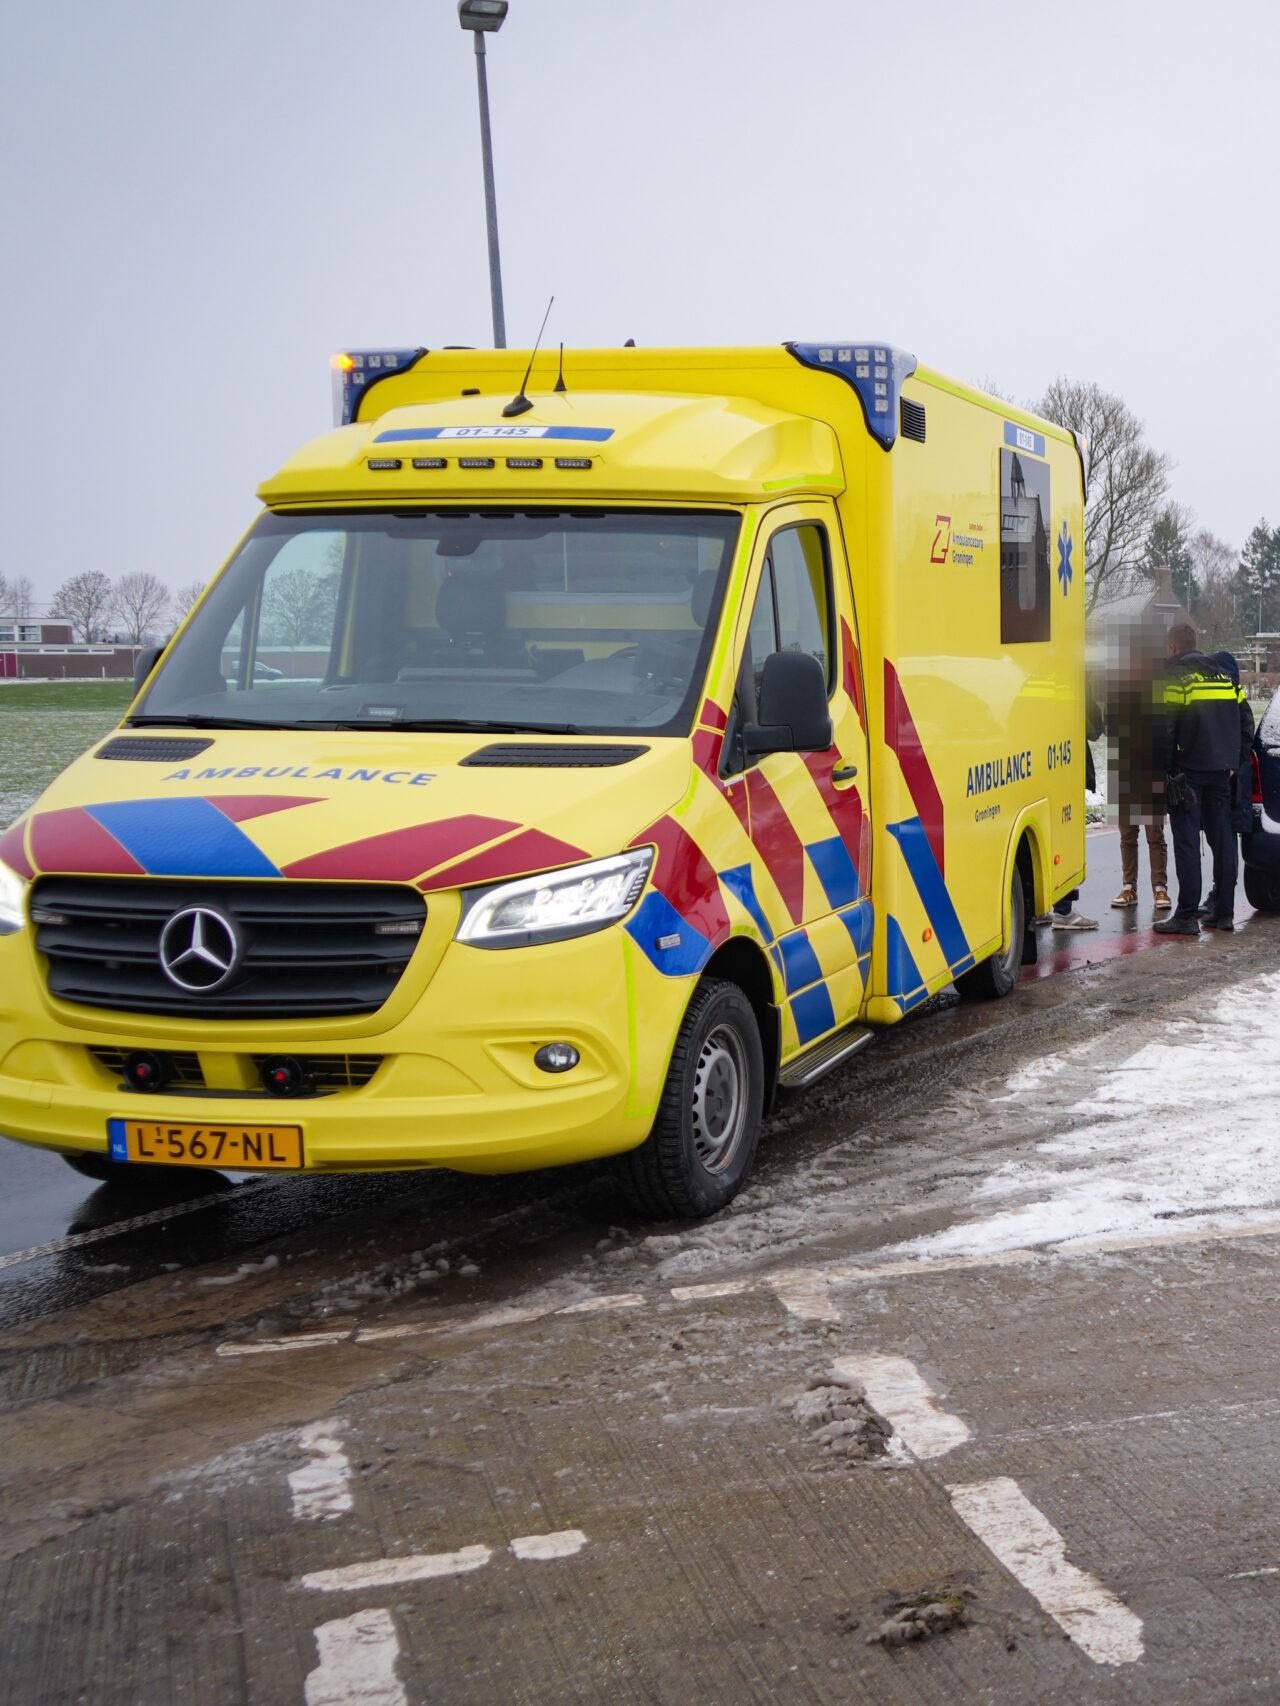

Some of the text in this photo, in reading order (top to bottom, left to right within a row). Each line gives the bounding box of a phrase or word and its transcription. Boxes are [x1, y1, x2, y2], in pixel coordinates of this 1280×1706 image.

[456, 428, 530, 436] 01-145
[160, 766, 437, 786] AMBULANCE
[966, 740, 1071, 798] AMBULANCE 01-145
[975, 804, 1000, 822] Groningen
[113, 1127, 287, 1162] NL L-567-NL
